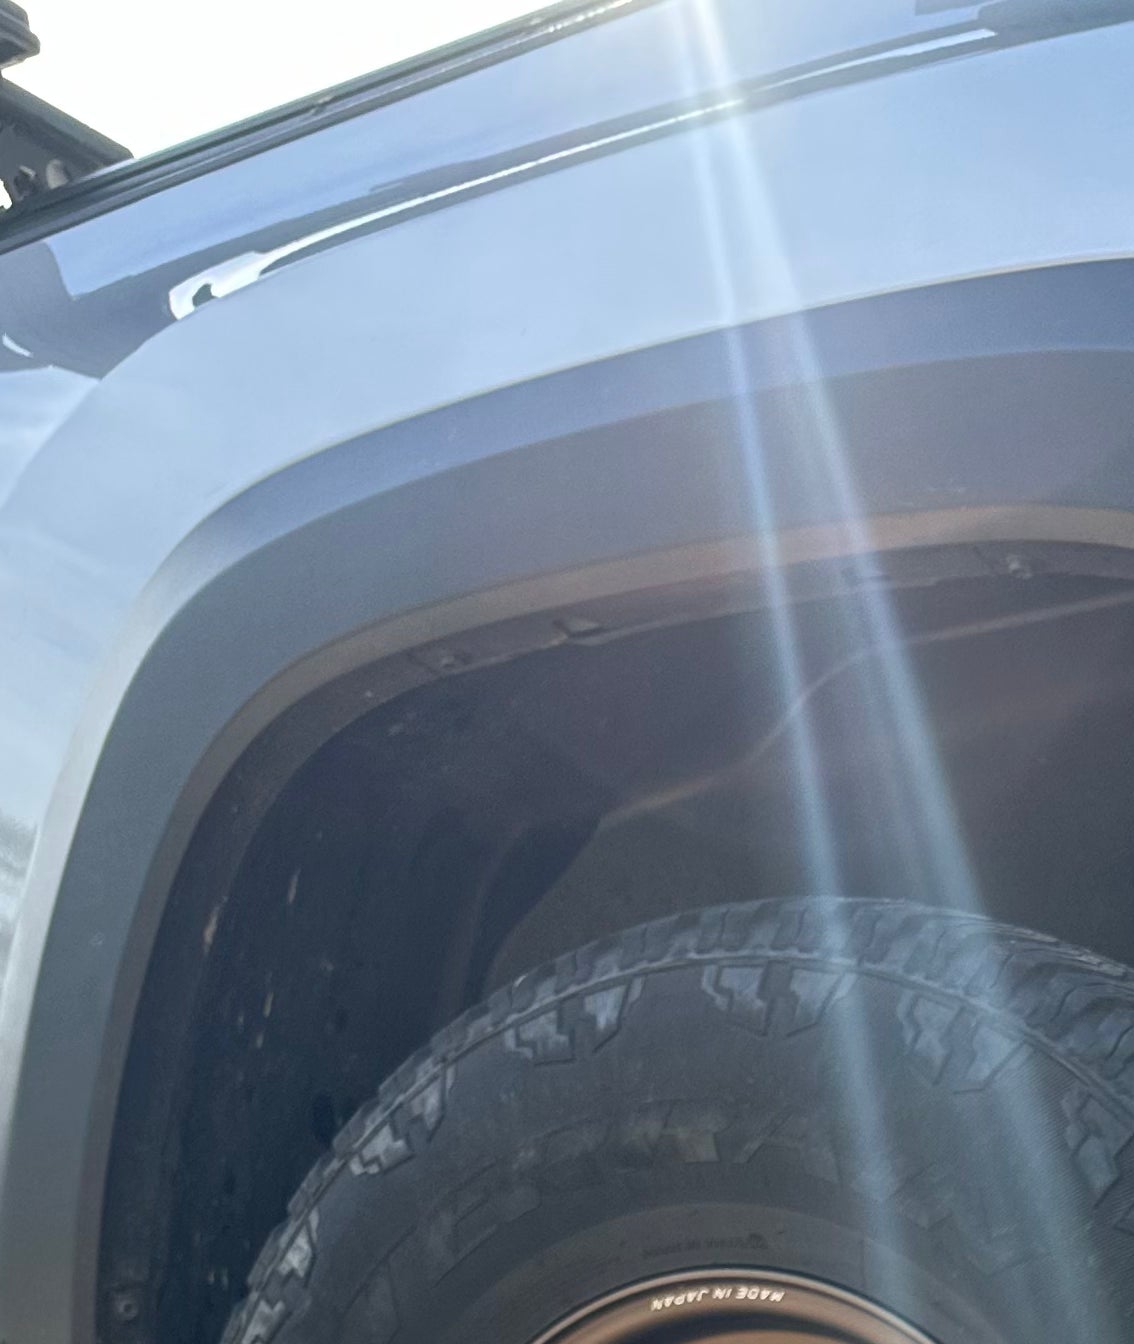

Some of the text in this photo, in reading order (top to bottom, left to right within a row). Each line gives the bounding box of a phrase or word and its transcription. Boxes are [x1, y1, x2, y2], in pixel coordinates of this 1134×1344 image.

[649, 1286, 785, 1311] MADE IN JAPAN
